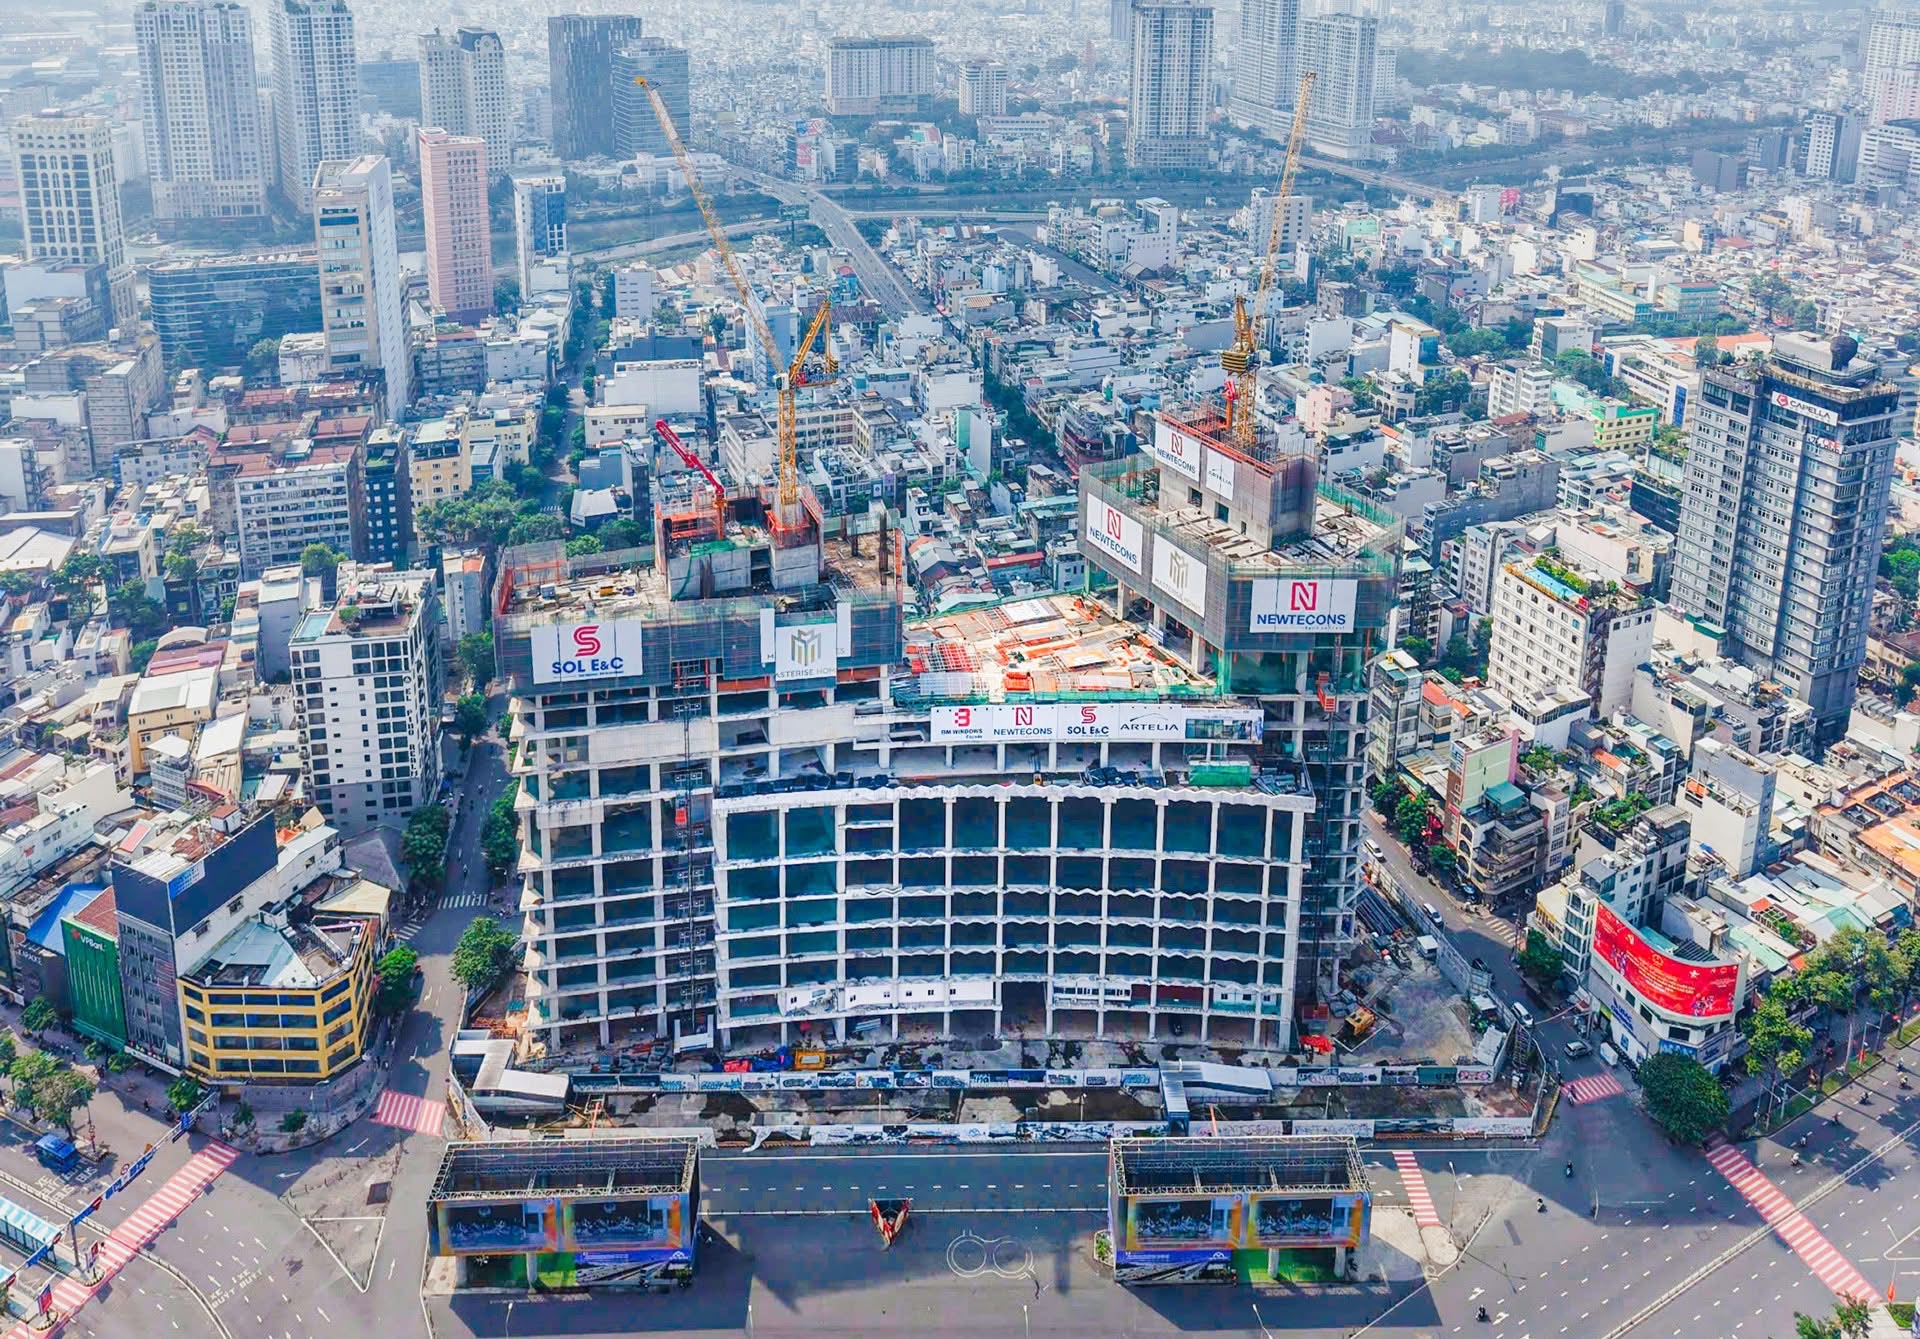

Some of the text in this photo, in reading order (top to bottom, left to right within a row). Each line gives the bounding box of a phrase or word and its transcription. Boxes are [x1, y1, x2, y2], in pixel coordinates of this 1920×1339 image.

[1157, 447, 1196, 474] NEWTECONS
[1089, 526, 1137, 565] NEWTECONS
[1256, 614, 1346, 625] NEWTECONS
[552, 660, 586, 674] SOL
[591, 657, 624, 671] E&C
[993, 728, 1053, 736] NEWTECONS
[1067, 726, 1110, 735] SOL E&C
